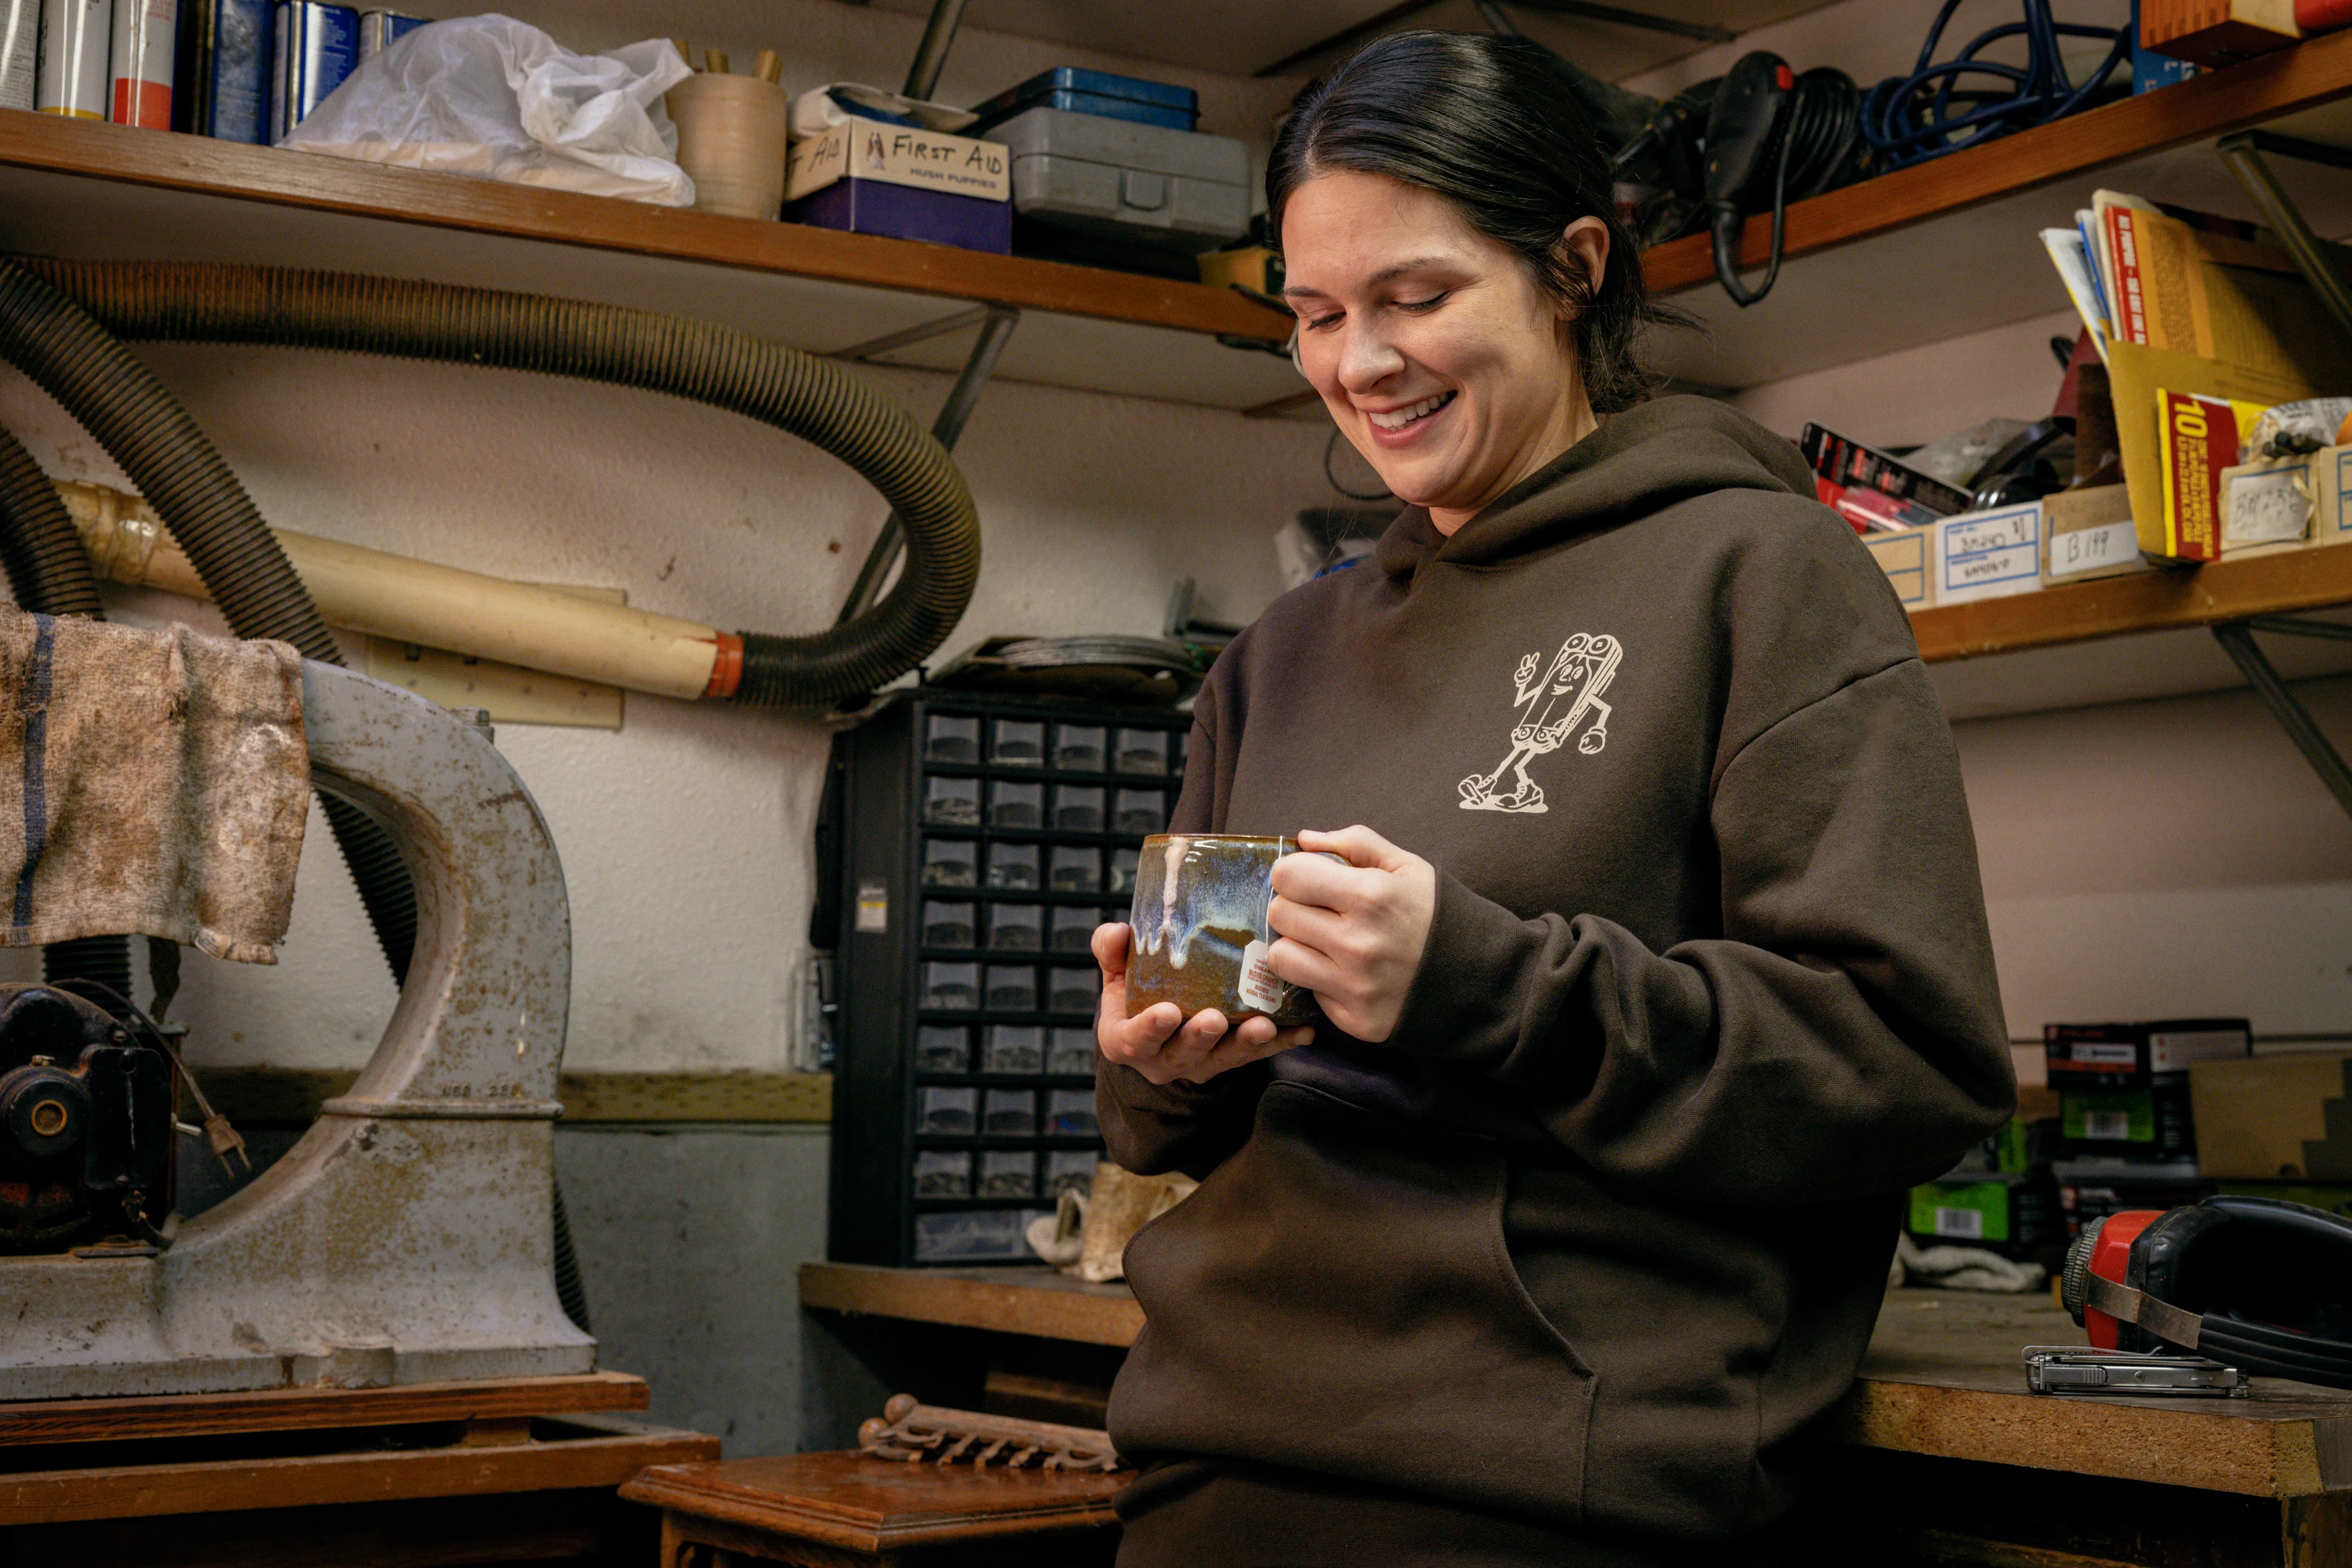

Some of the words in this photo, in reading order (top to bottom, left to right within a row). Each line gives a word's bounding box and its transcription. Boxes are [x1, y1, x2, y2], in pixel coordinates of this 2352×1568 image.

[892, 134, 956, 161] FIRST
[964, 145, 1003, 175] AID
[2174, 399, 2208, 438] 10
[1249, 969, 1262, 979] BLOOD
[1262, 973, 1279, 986] ORANGE
[1246, 988, 1259, 998] HERBAL
[1265, 994, 1276, 1004] BLEND
